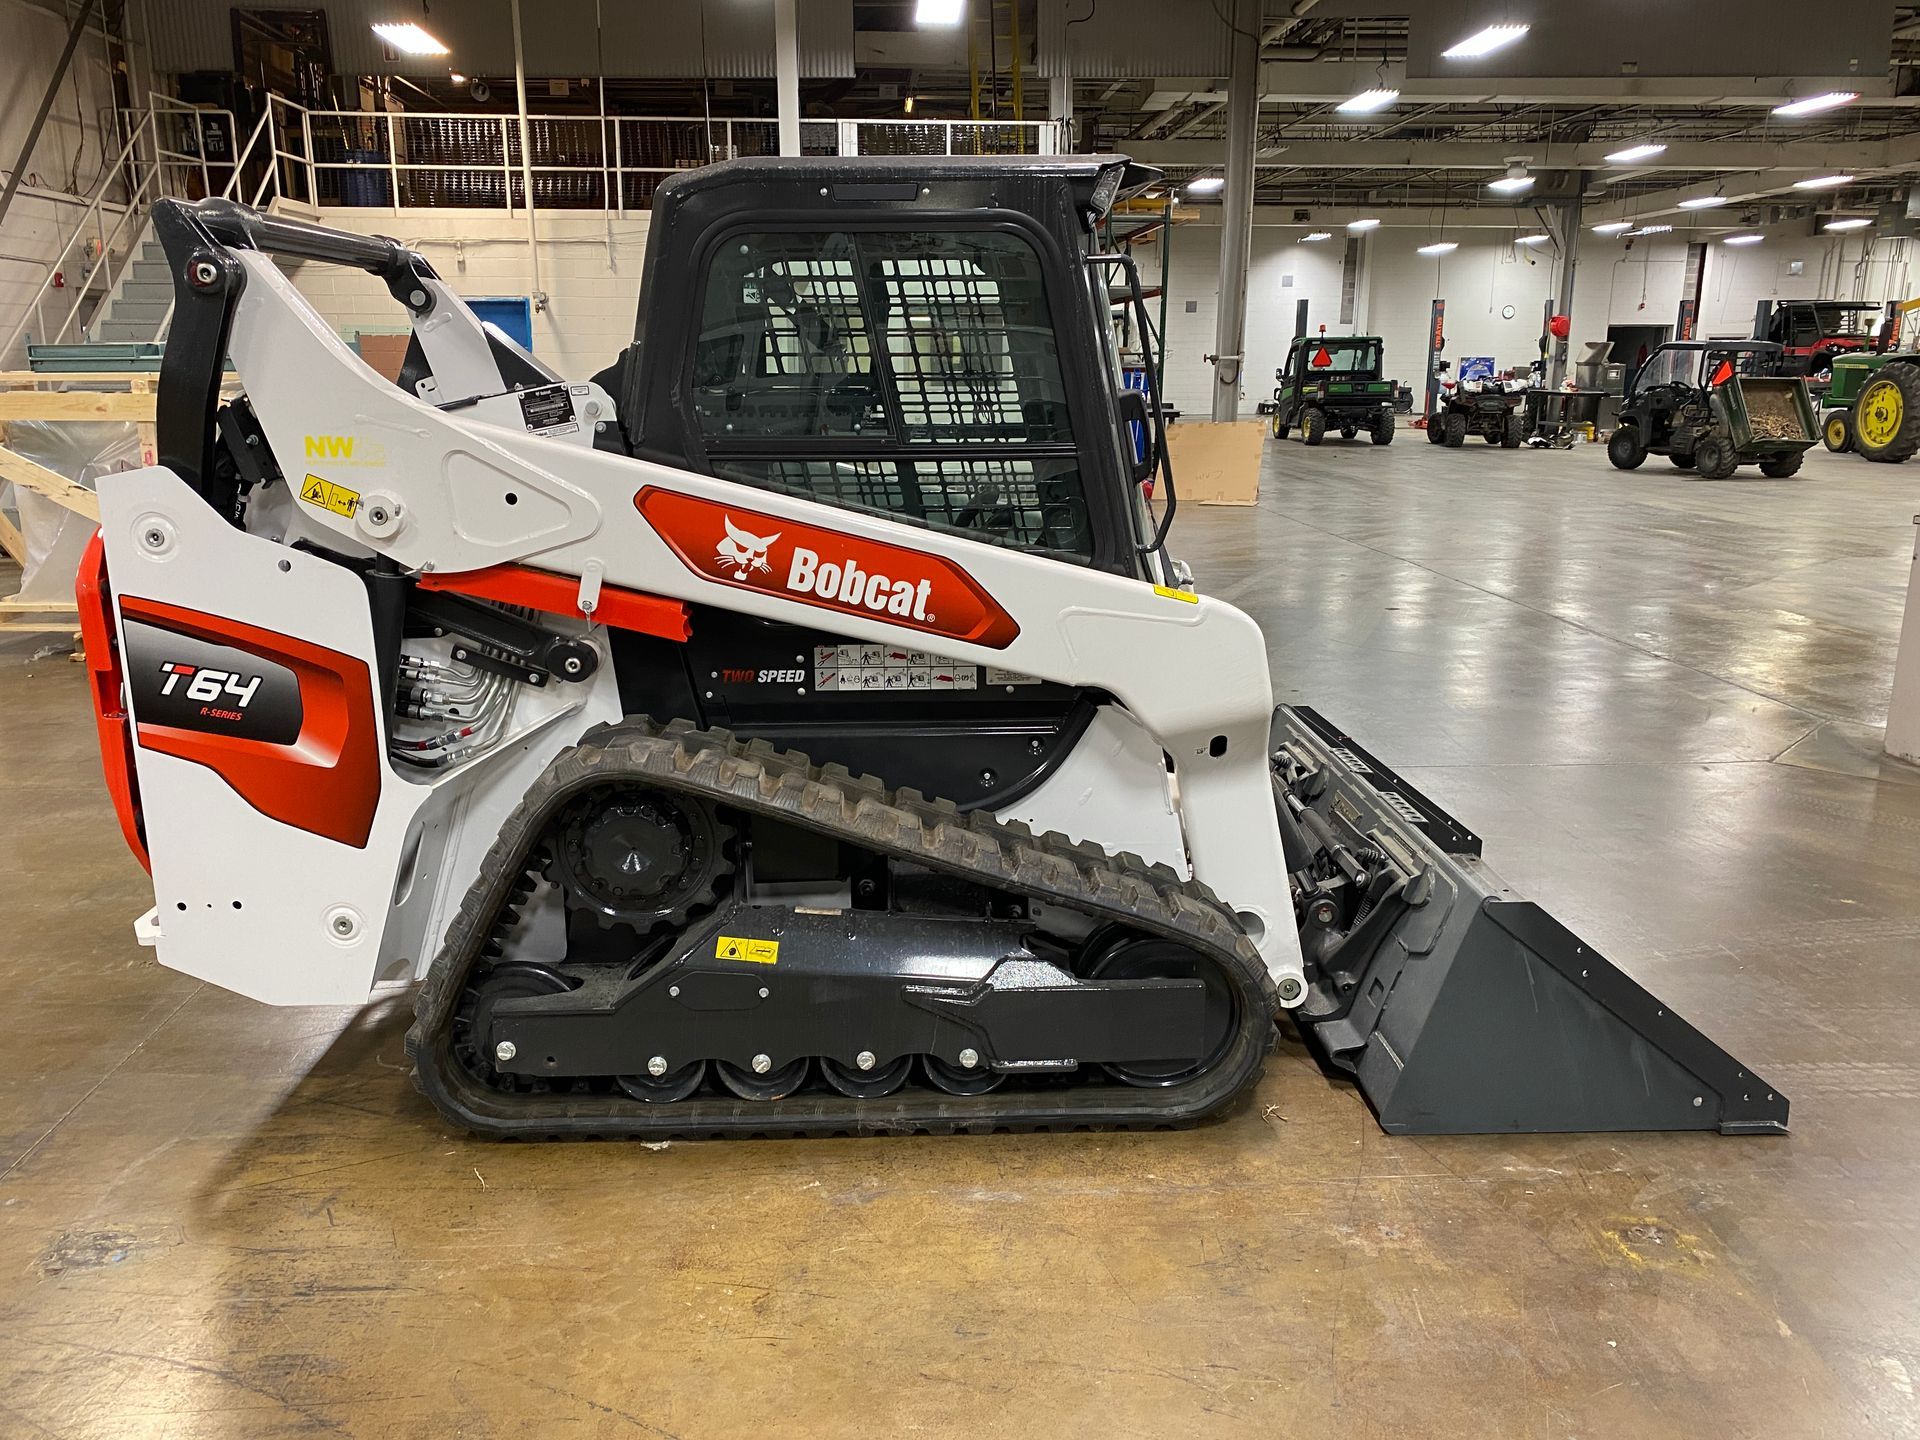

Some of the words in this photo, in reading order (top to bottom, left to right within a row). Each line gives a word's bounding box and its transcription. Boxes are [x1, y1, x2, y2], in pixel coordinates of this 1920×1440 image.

[304, 435, 353, 459] NW
[786, 547, 931, 621] Bobcat
[161, 662, 262, 708] T64
[722, 669, 755, 683] TWO
[757, 669, 805, 683] SPEED
[200, 707, 243, 721] R-SERIES
